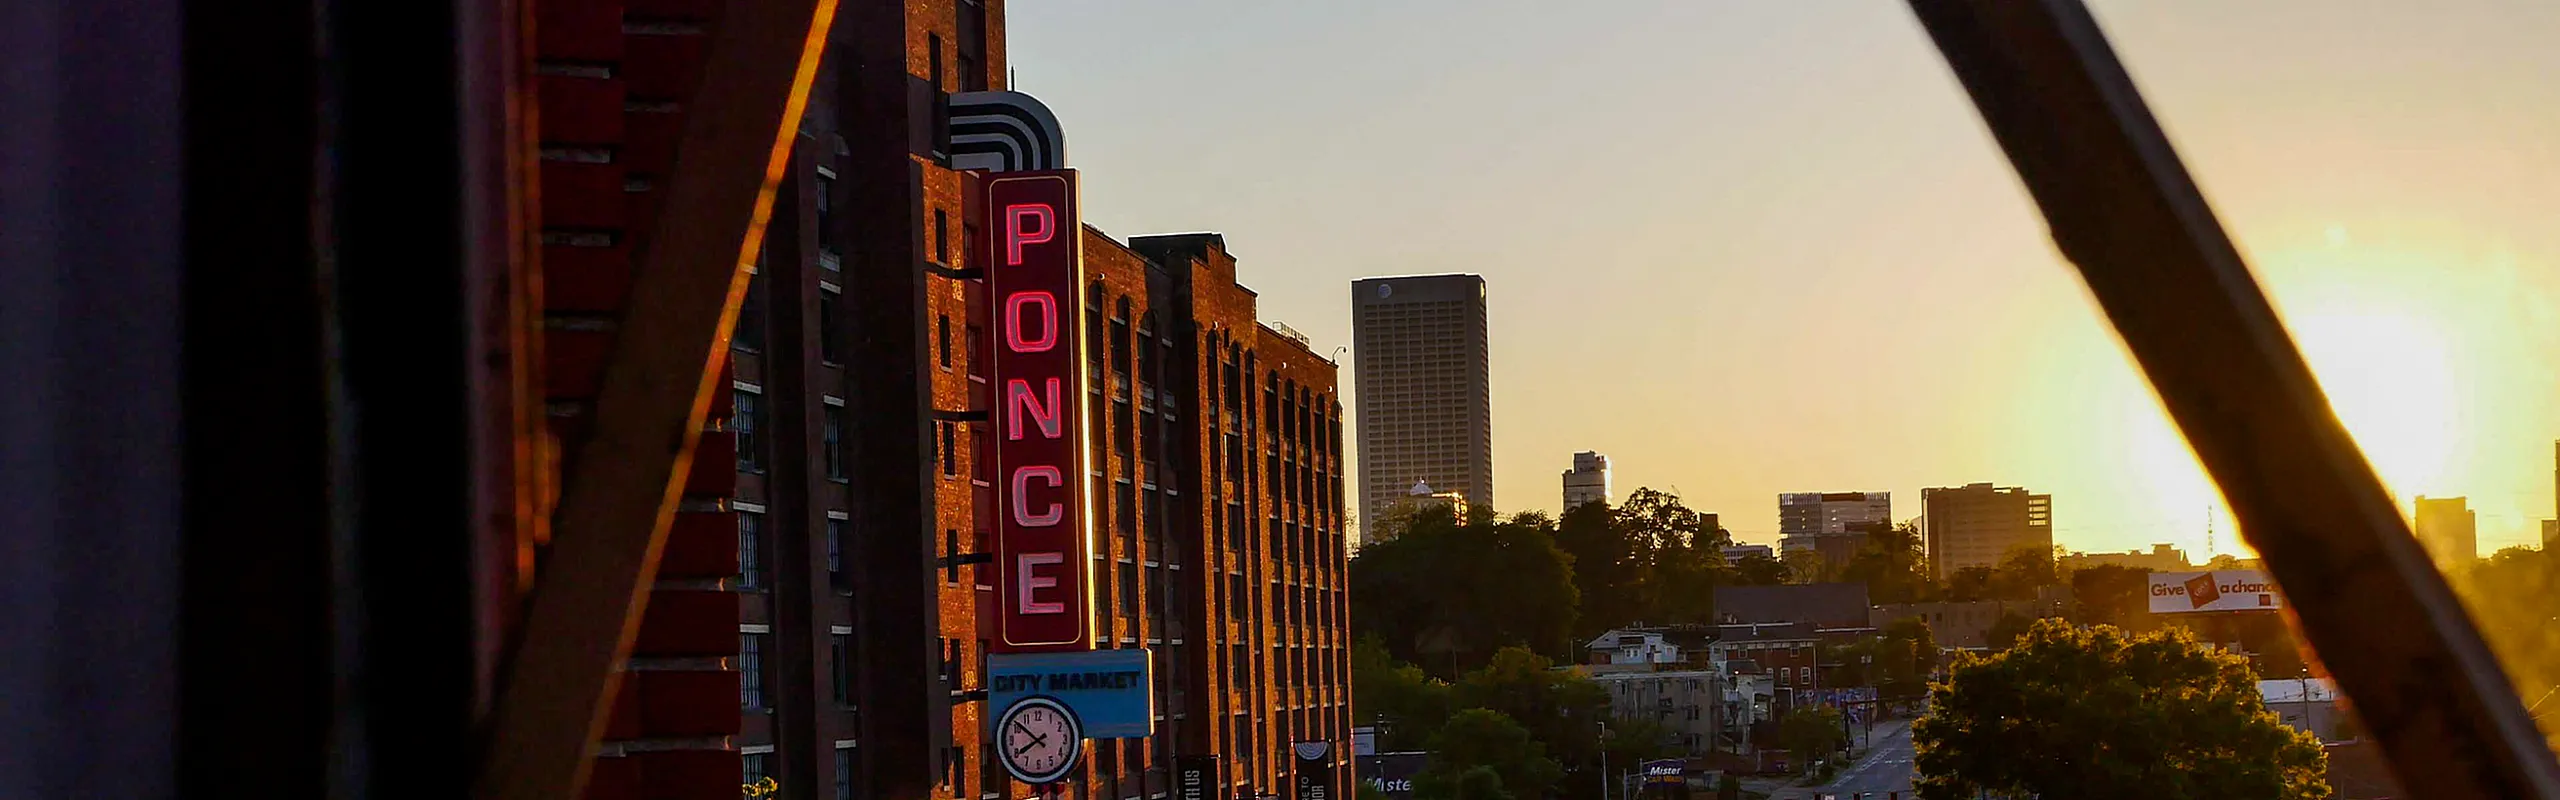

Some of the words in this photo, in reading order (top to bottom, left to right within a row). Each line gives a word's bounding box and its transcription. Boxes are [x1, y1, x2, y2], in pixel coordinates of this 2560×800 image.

[1005, 202, 1065, 616] PONCE
[2151, 583, 2184, 596] Give
[2220, 585, 2229, 593] a
[994, 674, 1042, 692] CITY
[1050, 671, 1140, 691] MARKET
[1023, 714, 1030, 724] 11
[1034, 710, 1043, 722] 12
[1048, 713, 1053, 724] 1
[1013, 723, 1022, 734] 10
[1057, 721, 1063, 732] 2
[1009, 735, 1015, 746] 9
[1062, 734, 1068, 744] 3
[1057, 747, 1063, 758] 4
[1023, 756, 1029, 767] 7
[1036, 759, 1042, 770] 6
[1048, 755, 1054, 767] 5
[1650, 766, 1681, 776] Mister
[1184, 770, 1200, 786] US
[1365, 777, 1414, 792] Miste
[1311, 785, 1324, 800] OR
